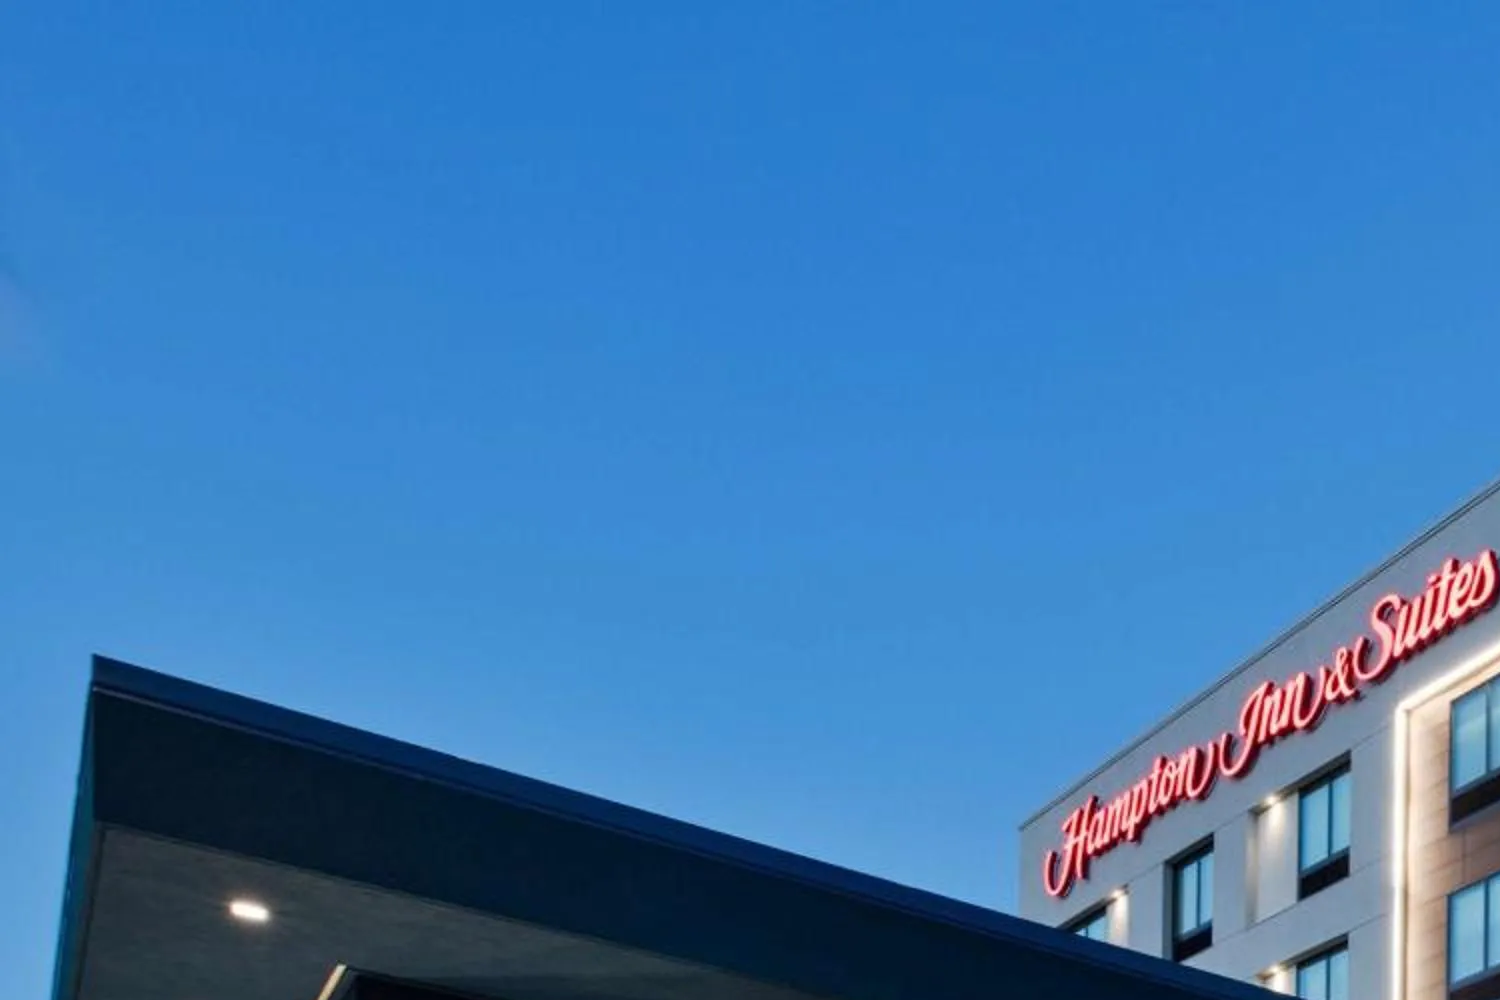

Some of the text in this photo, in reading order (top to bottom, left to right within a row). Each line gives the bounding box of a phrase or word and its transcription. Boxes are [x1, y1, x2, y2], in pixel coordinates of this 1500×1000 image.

[1043, 740, 1219, 897] Hampton
[1220, 667, 1328, 778] Inn
[1325, 647, 1356, 703] &
